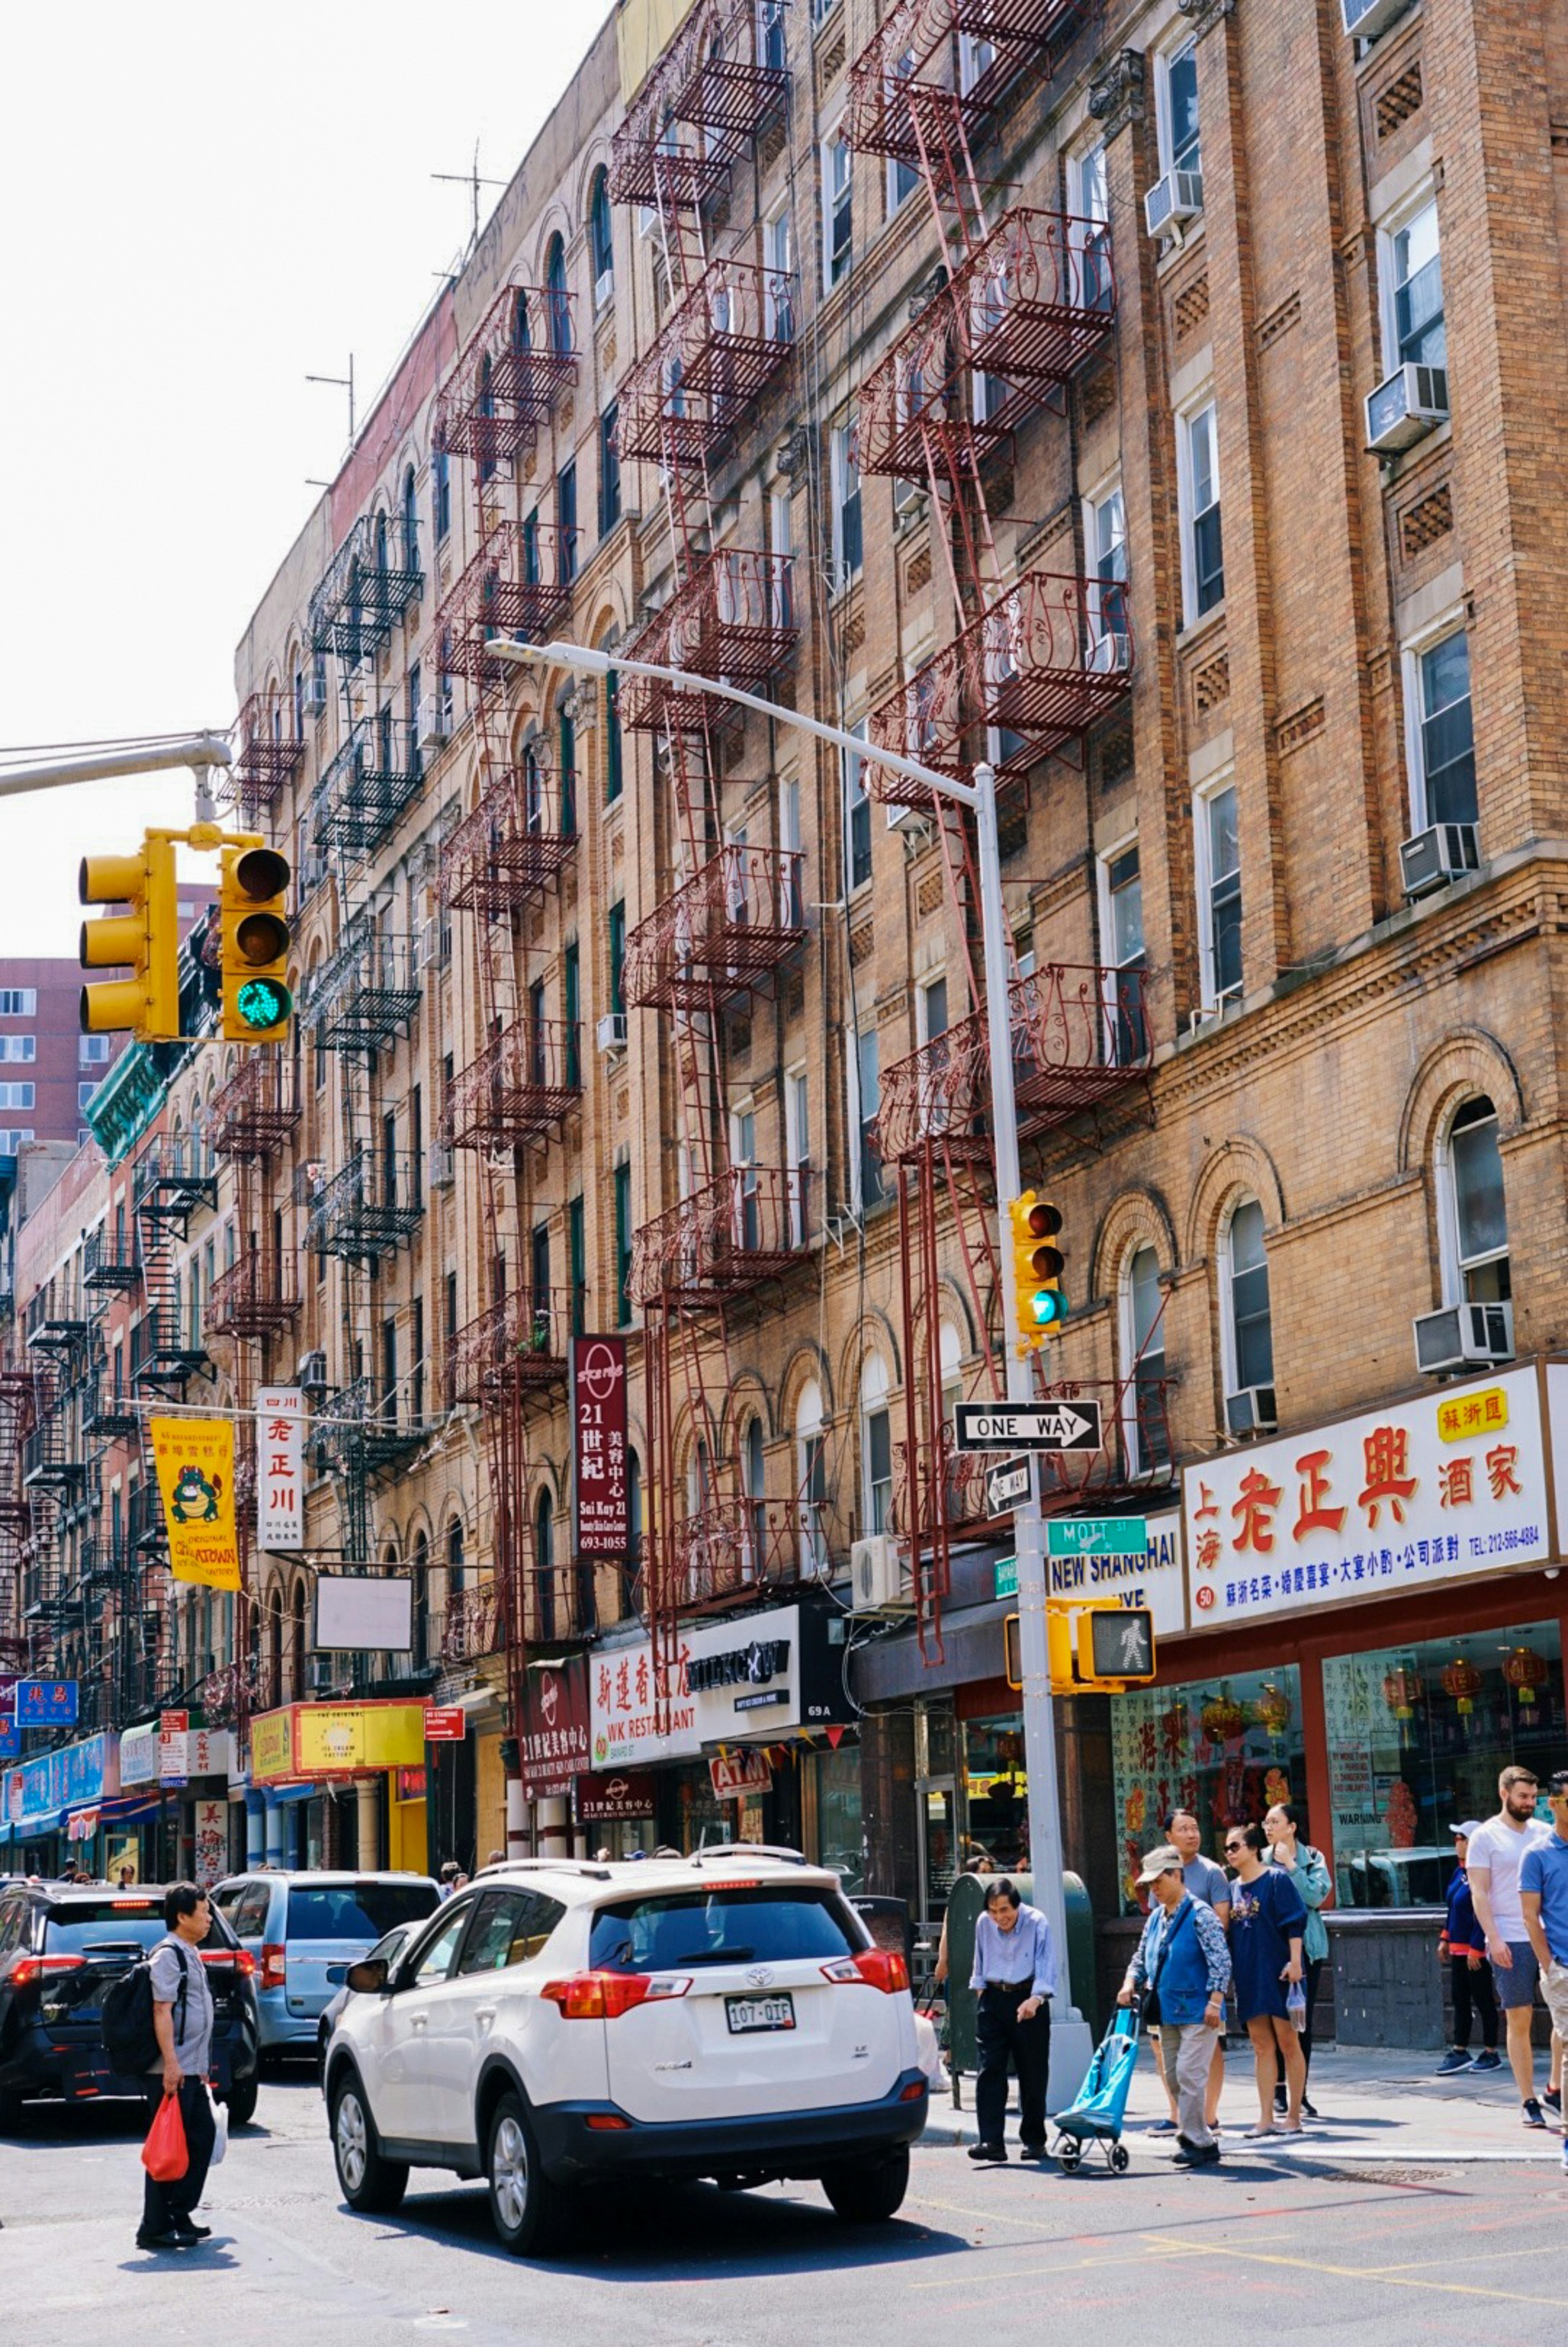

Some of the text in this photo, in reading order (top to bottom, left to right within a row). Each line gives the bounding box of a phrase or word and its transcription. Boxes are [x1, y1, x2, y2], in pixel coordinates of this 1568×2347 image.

[978, 1417, 1078, 1436] ONE WAY
[268, 1418, 295, 1512] 老正川
[992, 1471, 1024, 1500] ONE WAY
[1439, 1445, 1521, 1509] 酒家
[1231, 1427, 1418, 1552] 老正興
[580, 1501, 626, 1518] Sai Kay 21
[1063, 1522, 1127, 1542] MOTT ST
[1193, 1481, 1220, 1570] 上海
[580, 1536, 627, 1550] 693-1055
[1469, 1535, 1487, 1557] TEL:
[1052, 1556, 1084, 1591] NEW
[1090, 1532, 1176, 1583] SHANGHAI
[1200, 1591, 1212, 1605] 50
[607, 1721, 625, 1742] WK
[718, 1753, 765, 1787] ATM
[583, 1799, 653, 1812] 21世紀美容中心
[1339, 1813, 1381, 1825] WARNING
